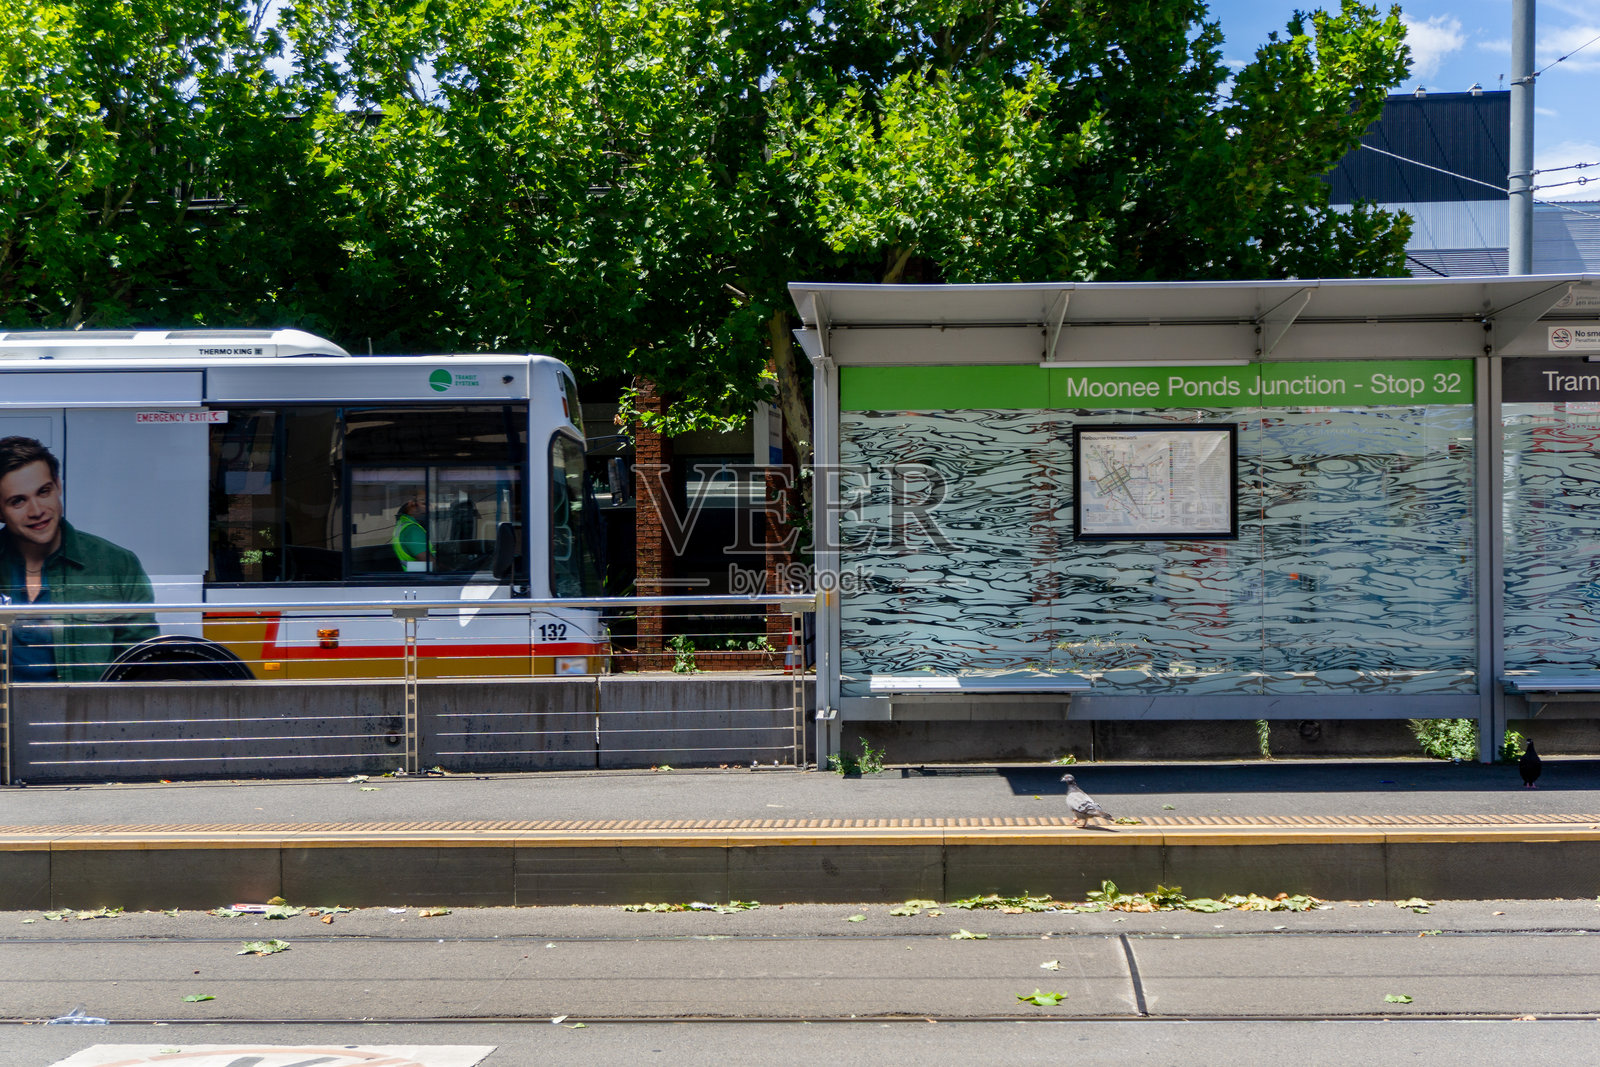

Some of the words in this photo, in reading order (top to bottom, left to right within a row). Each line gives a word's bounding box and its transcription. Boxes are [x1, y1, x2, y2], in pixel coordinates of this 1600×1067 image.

[1066, 377, 1160, 397] Moonee
[1168, 376, 1241, 396] Ponds
[1248, 375, 1346, 396] Junction
[1370, 373, 1425, 398] Stop
[1433, 373, 1461, 393] 32
[1542, 370, 1600, 391] Tram
[136, 412, 185, 422] EMERGENCY
[189, 412, 206, 421] EXIT
[539, 623, 567, 641] 132
